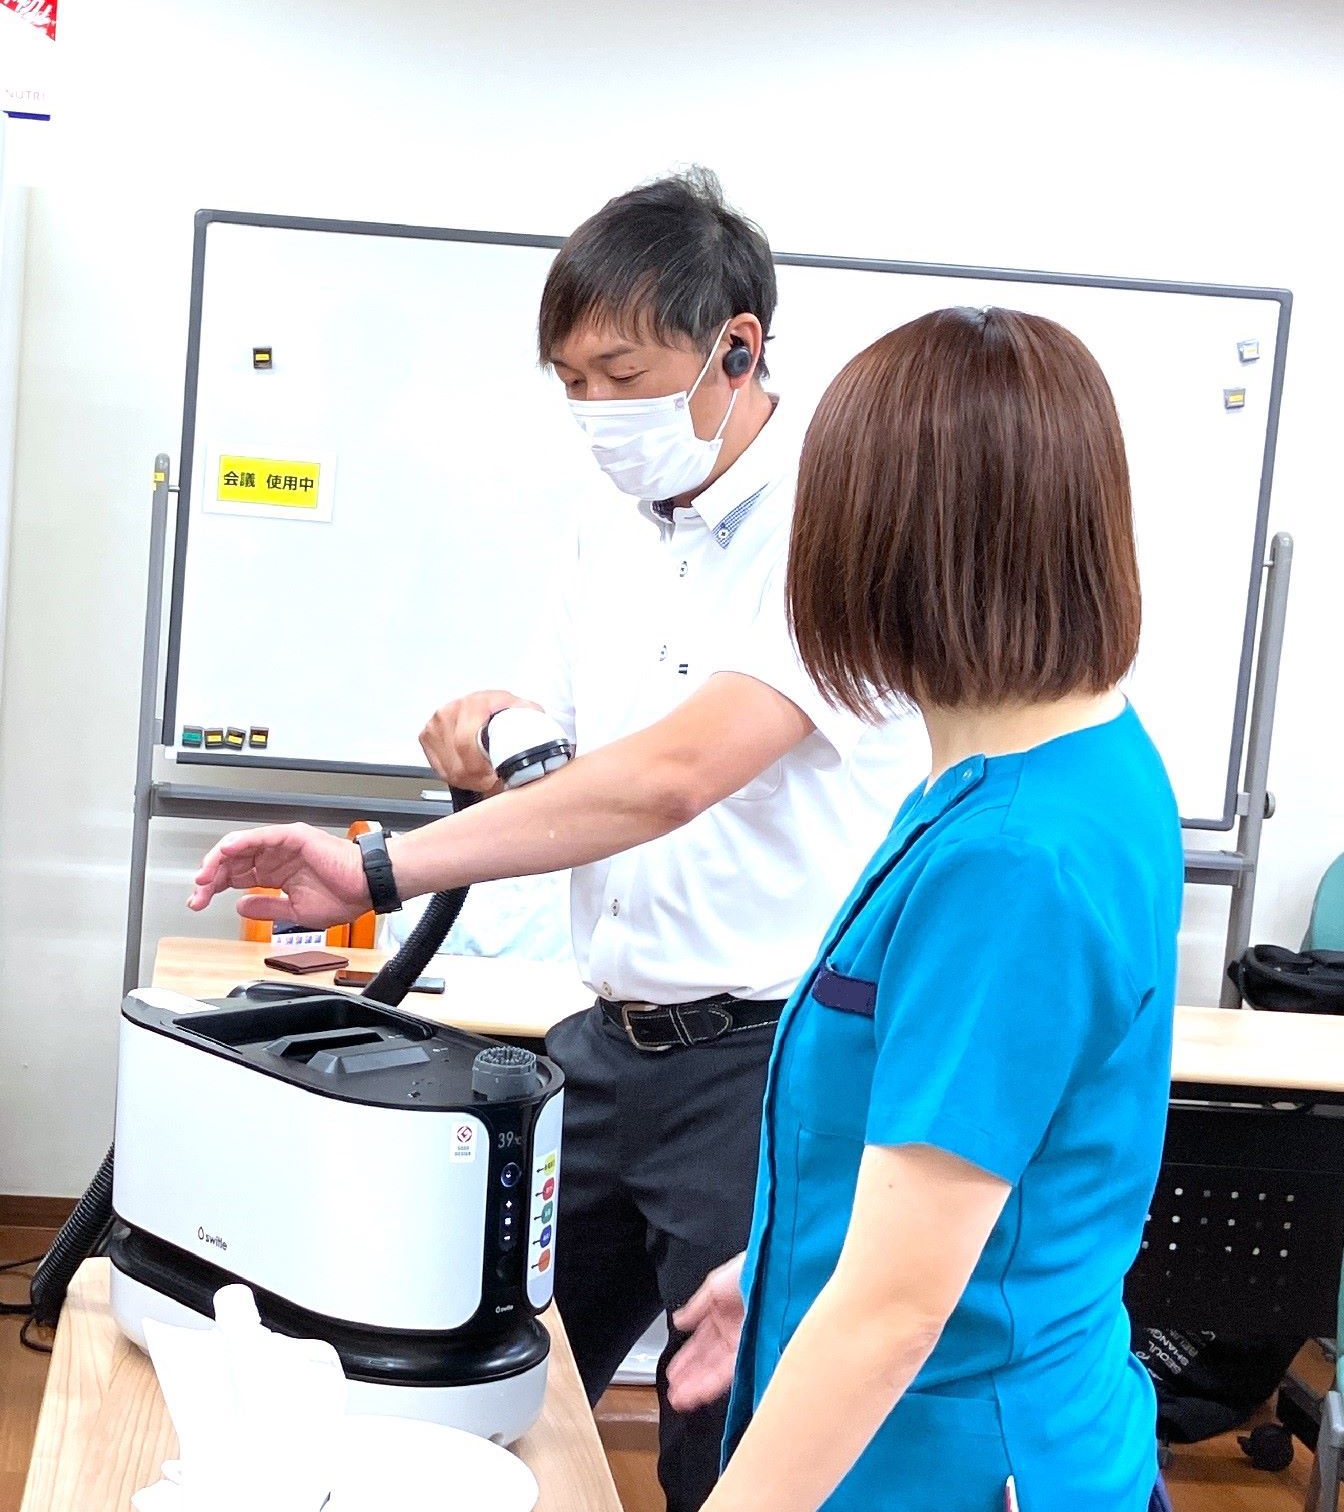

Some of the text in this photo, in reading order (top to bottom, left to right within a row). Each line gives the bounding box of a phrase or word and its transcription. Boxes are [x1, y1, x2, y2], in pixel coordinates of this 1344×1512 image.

[223, 470, 315, 493] 会議 使用中
